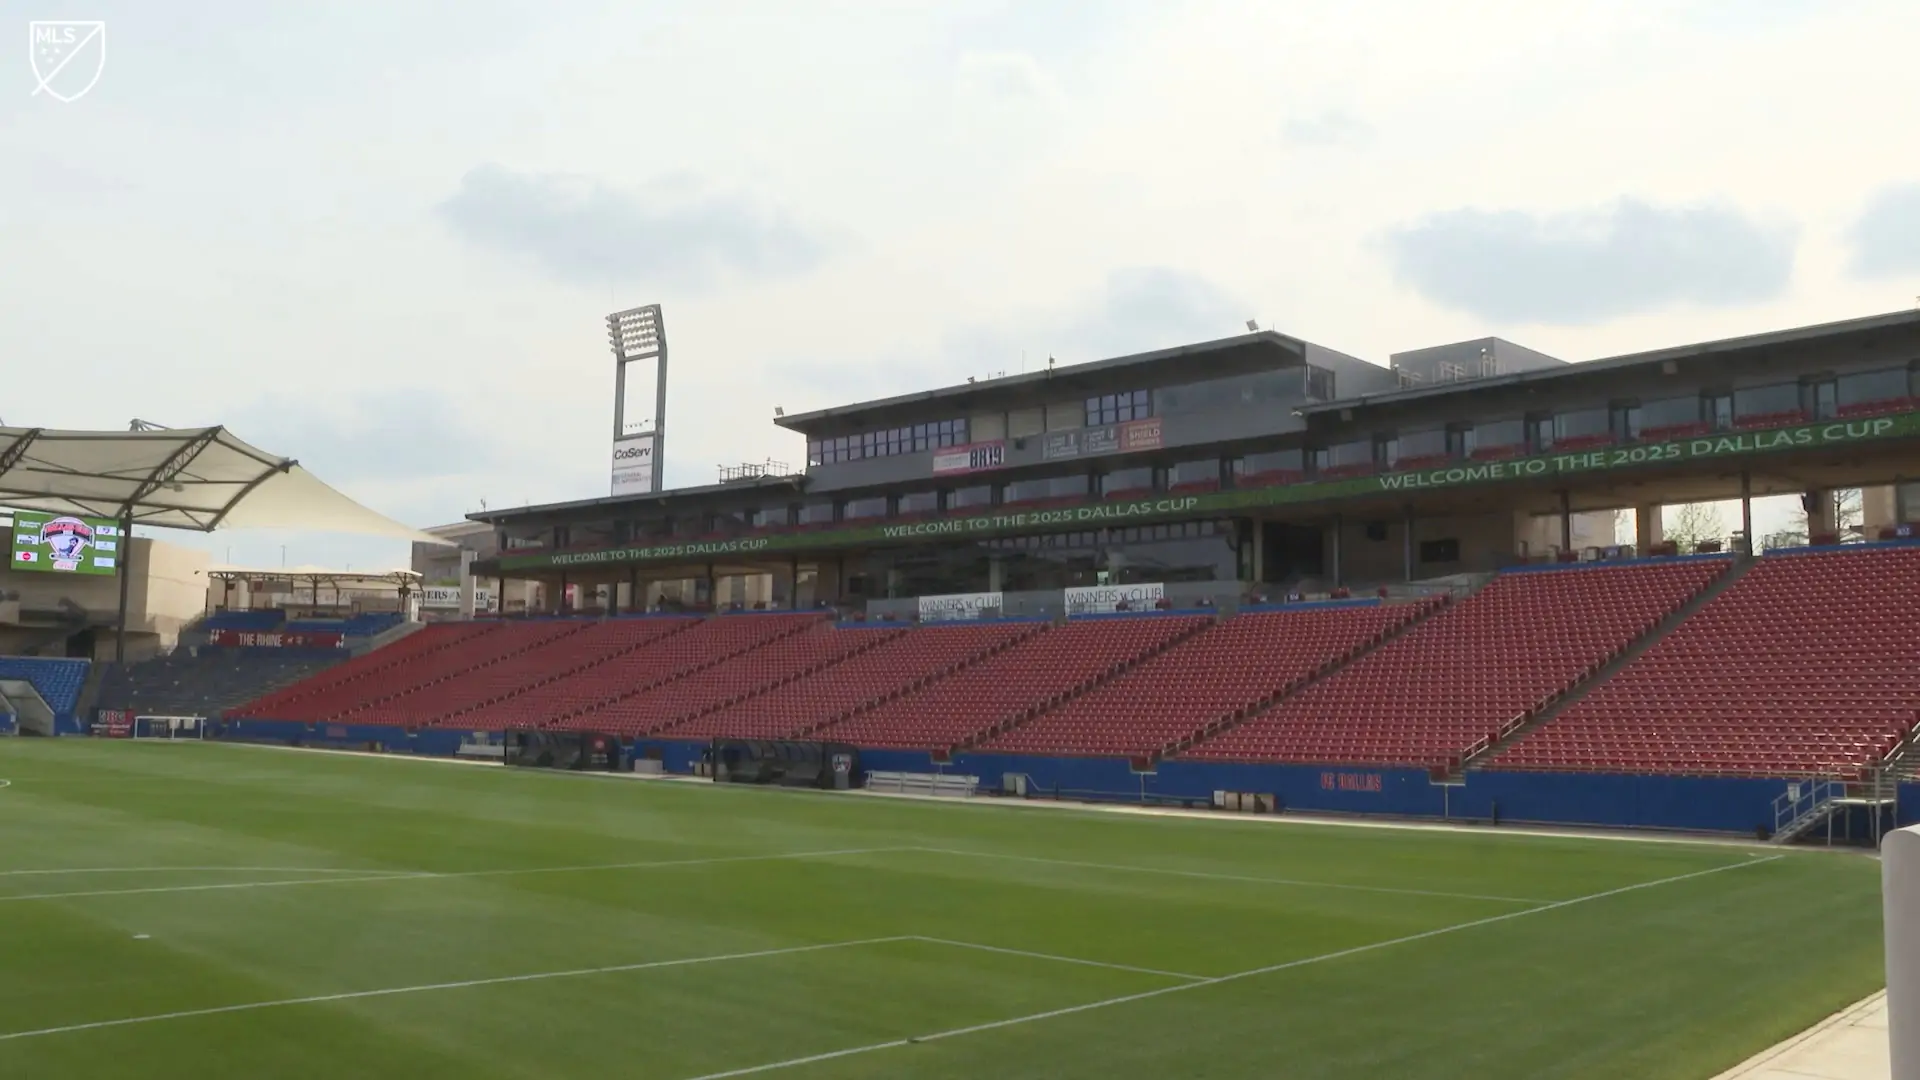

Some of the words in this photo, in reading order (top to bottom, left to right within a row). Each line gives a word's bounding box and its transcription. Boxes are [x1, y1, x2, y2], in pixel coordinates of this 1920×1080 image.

[614, 447, 651, 460] CoServ
[1380, 464, 1504, 490] WELCOME
[1509, 459, 1546, 477] TO
[1553, 452, 1605, 471] THE
[1612, 443, 1681, 465] 2025
[1691, 428, 1813, 456] DALLAS
[1822, 418, 1894, 441] CUP
[884, 520, 963, 538] WELCOME
[966, 517, 989, 531] TO
[993, 514, 1025, 528] THE
[1030, 510, 1073, 525] 2025
[1078, 502, 1151, 520] DALLAS
[1156, 497, 1198, 511] CUP
[551, 551, 607, 565] WELCOME
[610, 550, 626, 560] TO
[630, 548, 650, 559] THE
[654, 547, 683, 557] 2025
[687, 541, 737, 554] DALLAS
[740, 538, 768, 550] CUP
[920, 599, 963, 612] WINNERS
[975, 595, 1000, 609] CLUB
[1067, 590, 1118, 604] WINNERS
[1131, 587, 1162, 601] CLUB
[239, 633, 254, 646] THE
[1338, 773, 1382, 792] DALLAS
